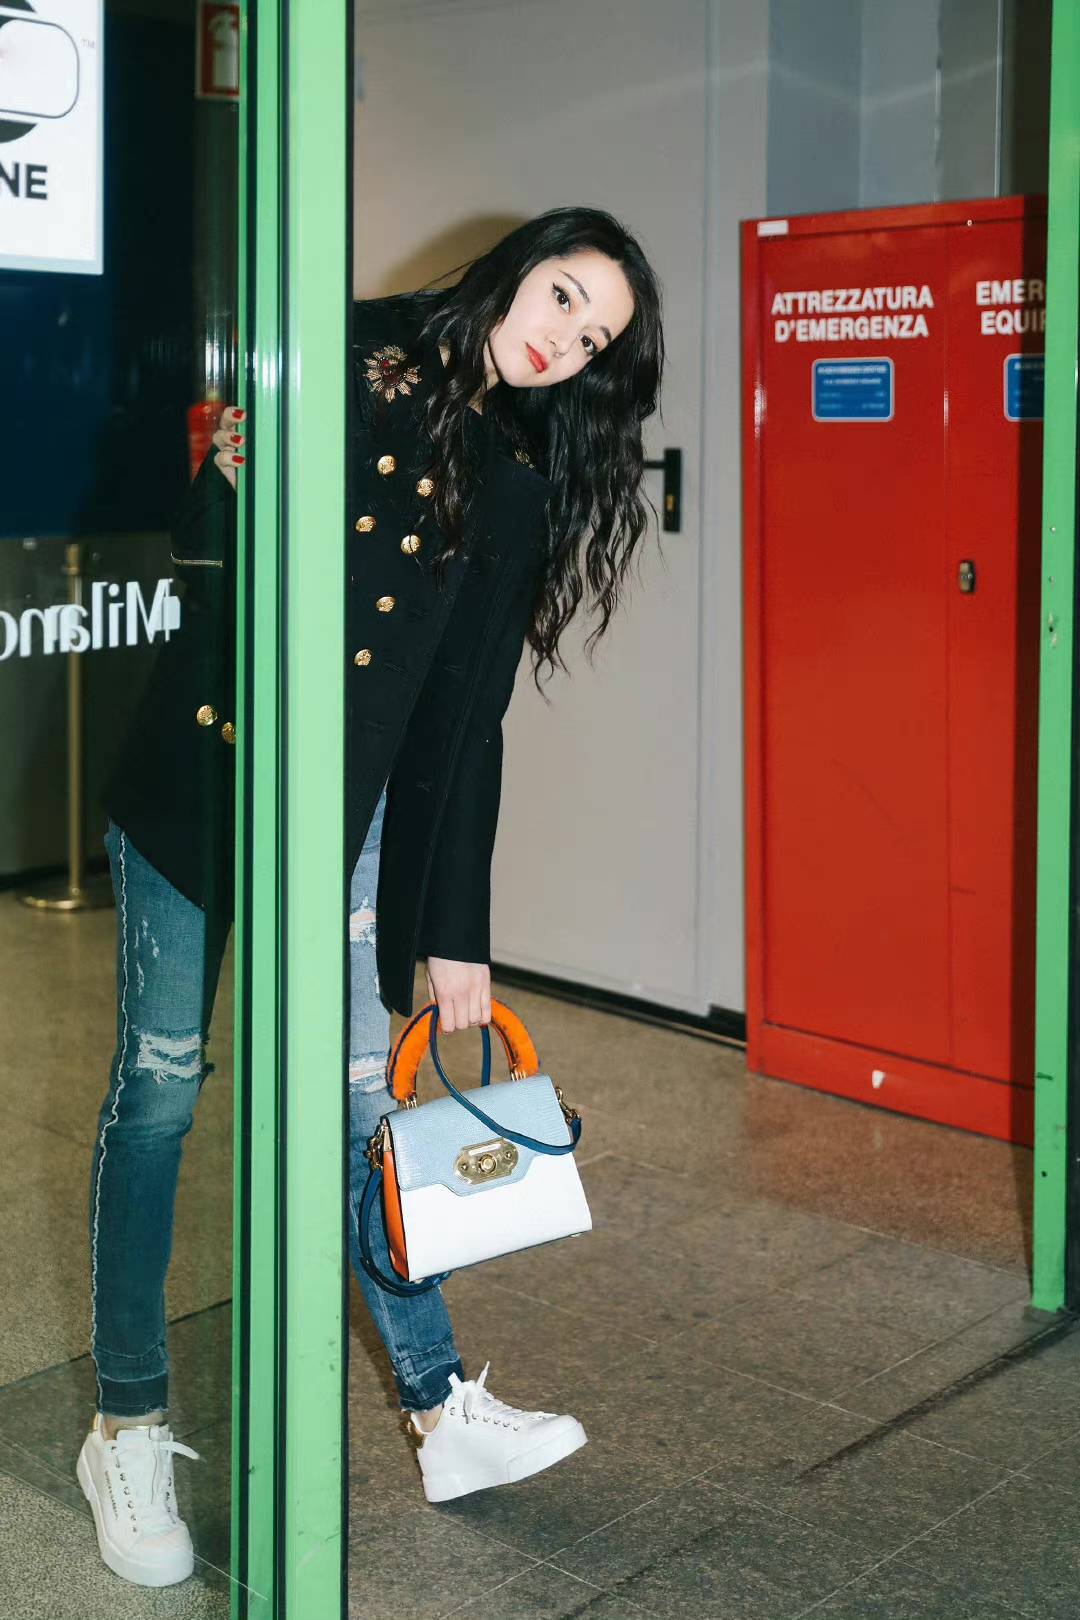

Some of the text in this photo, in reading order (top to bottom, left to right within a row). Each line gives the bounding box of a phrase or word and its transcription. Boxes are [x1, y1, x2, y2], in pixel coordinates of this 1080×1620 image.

[771, 285, 934, 315] ATTREZZATURA
[976, 279, 1045, 305] EMER
[774, 314, 929, 343] D'EMERGENZA
